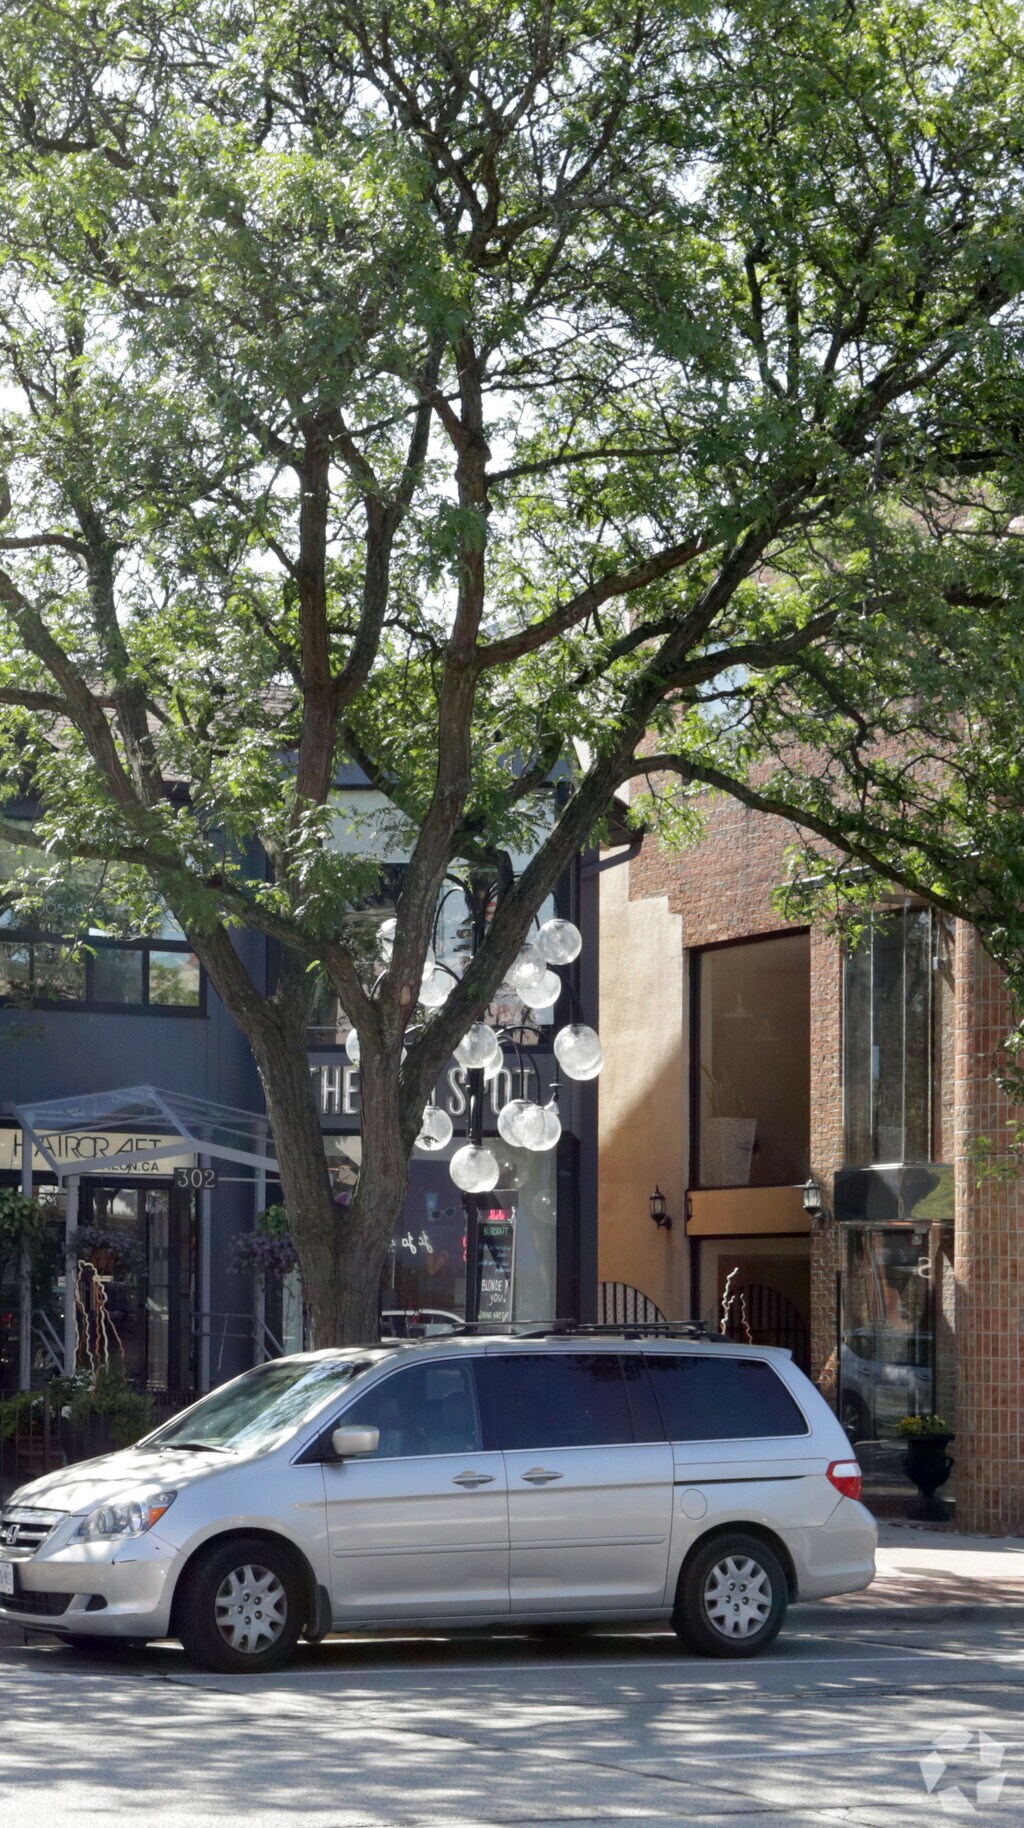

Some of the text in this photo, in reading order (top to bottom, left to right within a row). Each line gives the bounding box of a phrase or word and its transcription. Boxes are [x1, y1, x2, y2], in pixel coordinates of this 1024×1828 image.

[447, 1065, 537, 1116] SOT
[177, 1169, 216, 1189] 302
[481, 1279, 502, 1292] BLONDE
